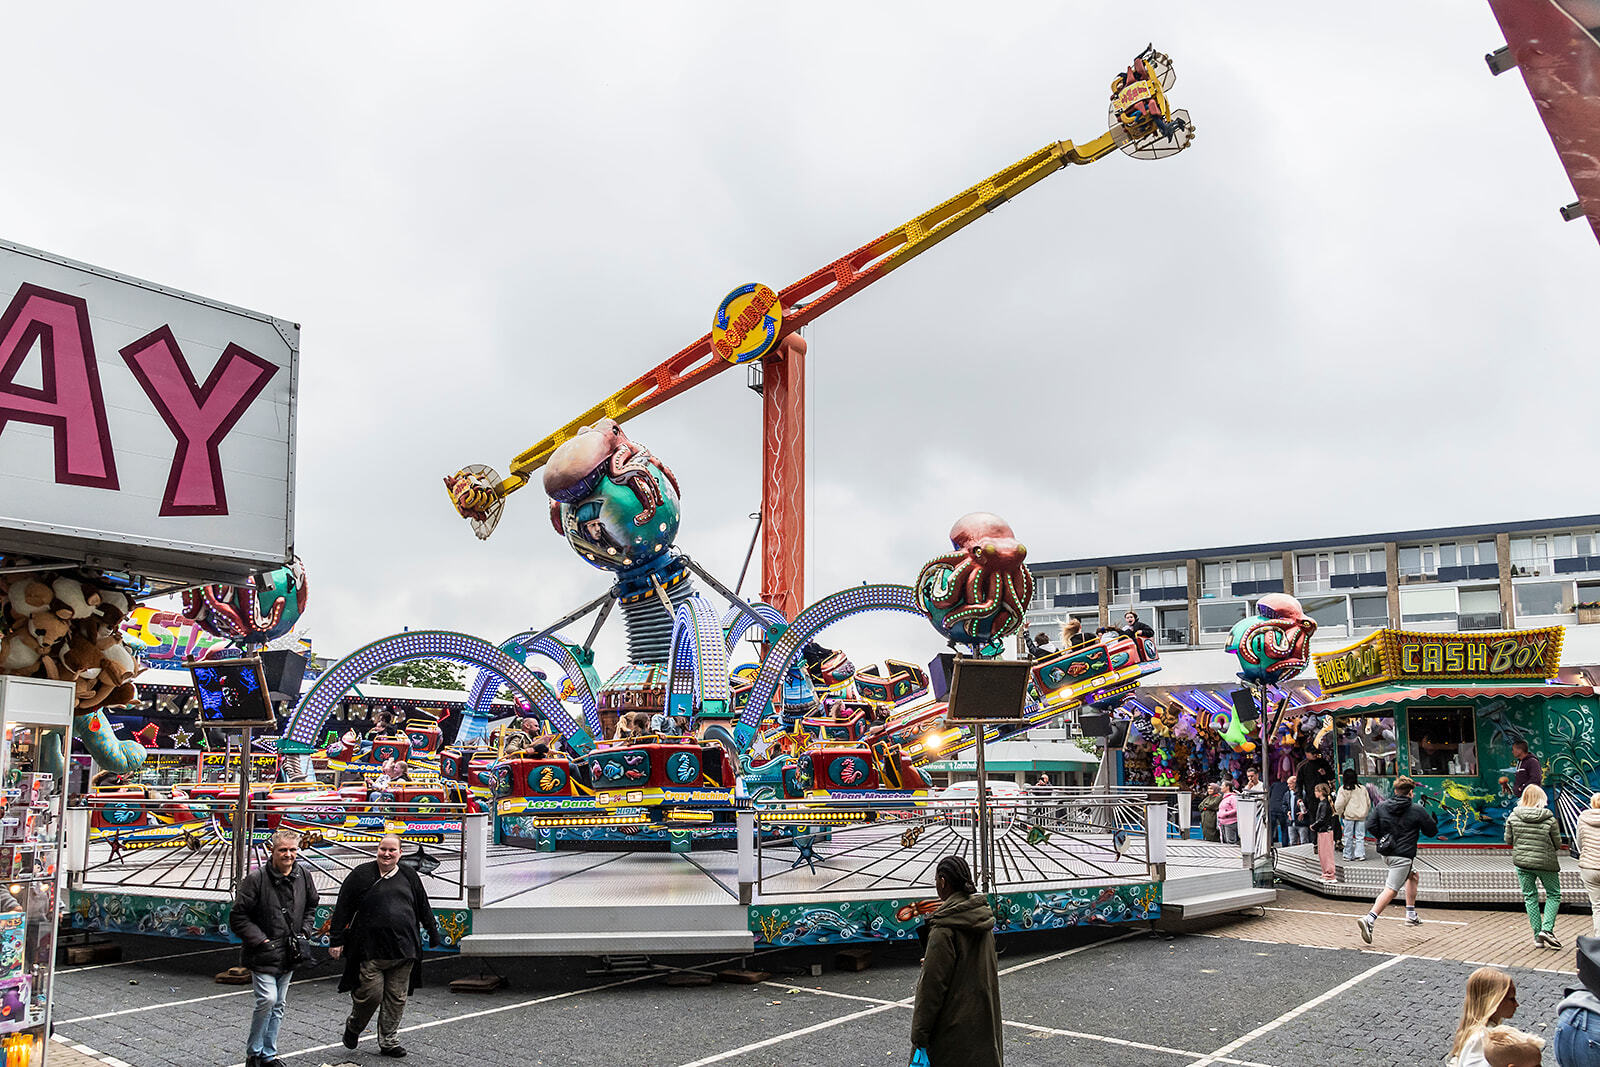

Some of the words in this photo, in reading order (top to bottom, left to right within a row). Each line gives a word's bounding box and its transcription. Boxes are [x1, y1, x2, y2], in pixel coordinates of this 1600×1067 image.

[714, 286, 777, 360] BOMBER
[1402, 643, 1488, 673] CASH
[1320, 655, 1351, 687] POWER
[527, 800, 558, 809] Lets
[664, 791, 691, 803] Crazy
[691, 791, 730, 801] Machine
[406, 822, 442, 831] Power
